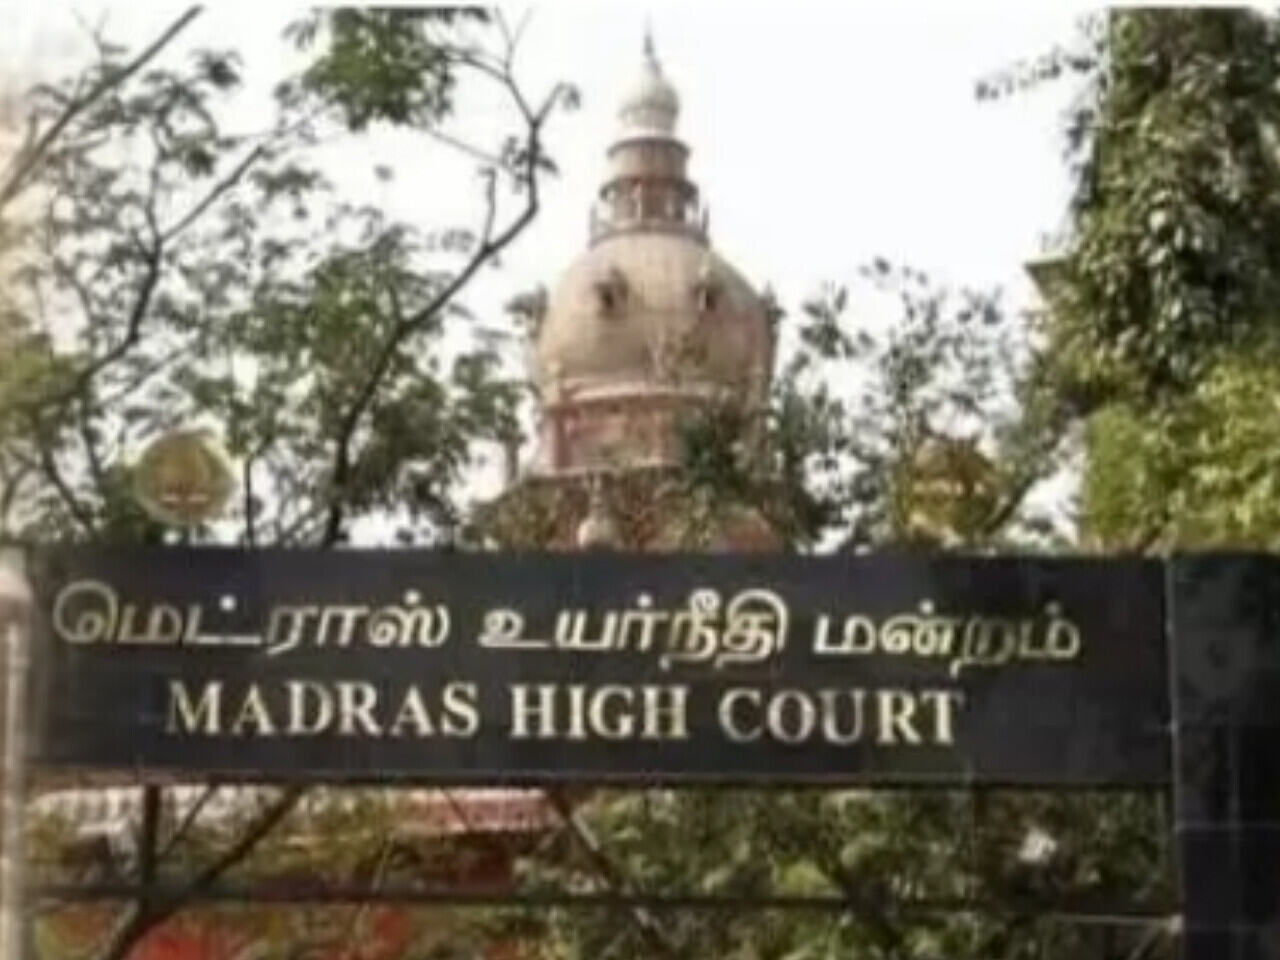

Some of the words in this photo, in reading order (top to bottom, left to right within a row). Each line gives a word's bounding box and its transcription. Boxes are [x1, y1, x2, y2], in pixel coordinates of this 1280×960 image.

[53, 579, 451, 656] மெட்ராஸ்
[477, 588, 789, 669] உயர்நீதி
[813, 599, 1081, 679] மன்றம்
[167, 678, 481, 738] MADRAS
[511, 684, 690, 739] HIGH
[719, 688, 965, 745] COURT
